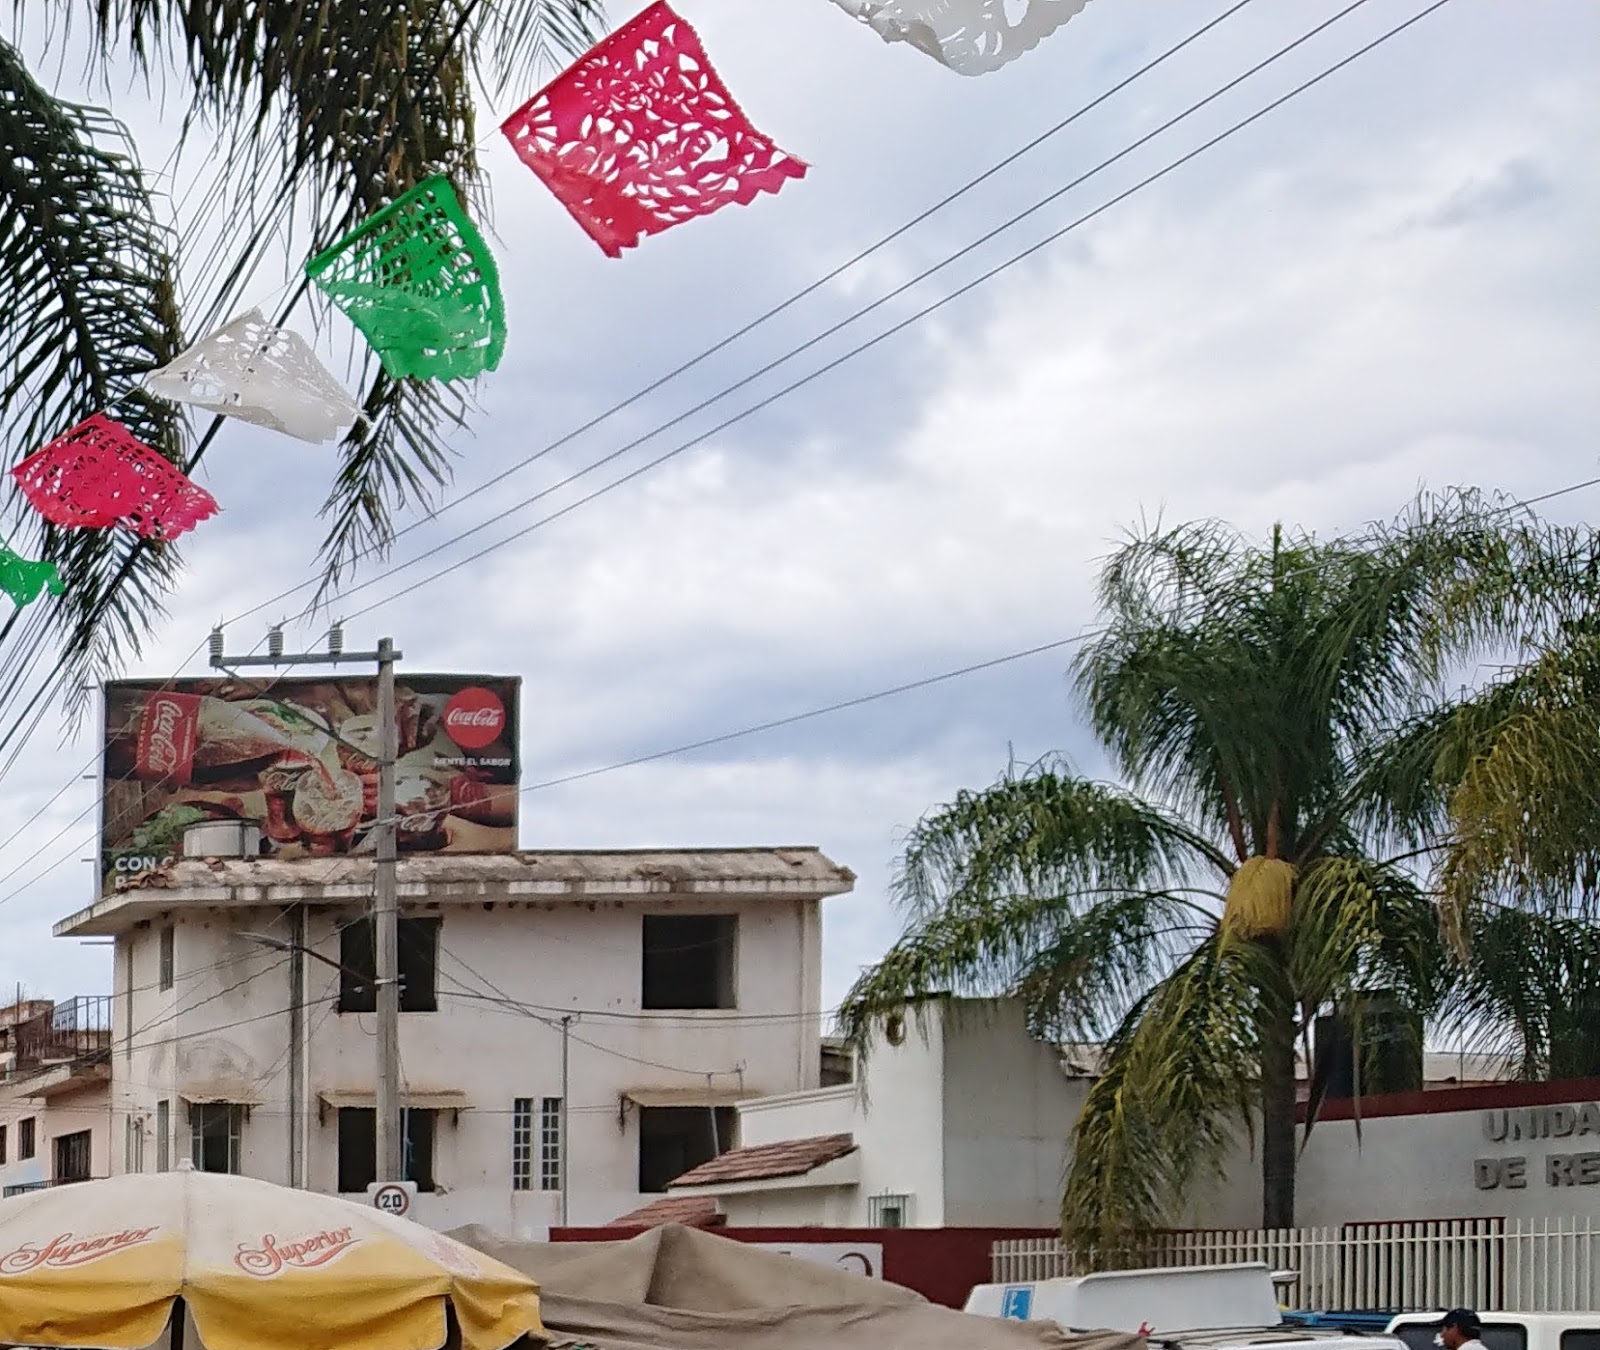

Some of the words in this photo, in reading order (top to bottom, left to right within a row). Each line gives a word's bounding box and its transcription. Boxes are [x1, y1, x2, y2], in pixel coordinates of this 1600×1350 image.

[447, 707, 504, 726] Coca-Cola
[467, 757, 478, 766] EL
[115, 855, 156, 871] CON
[1474, 1156, 1527, 1190] DE
[1545, 1151, 1600, 1187] RE
[382, 1194, 402, 1208] 20
[234, 1226, 362, 1277] Superior
